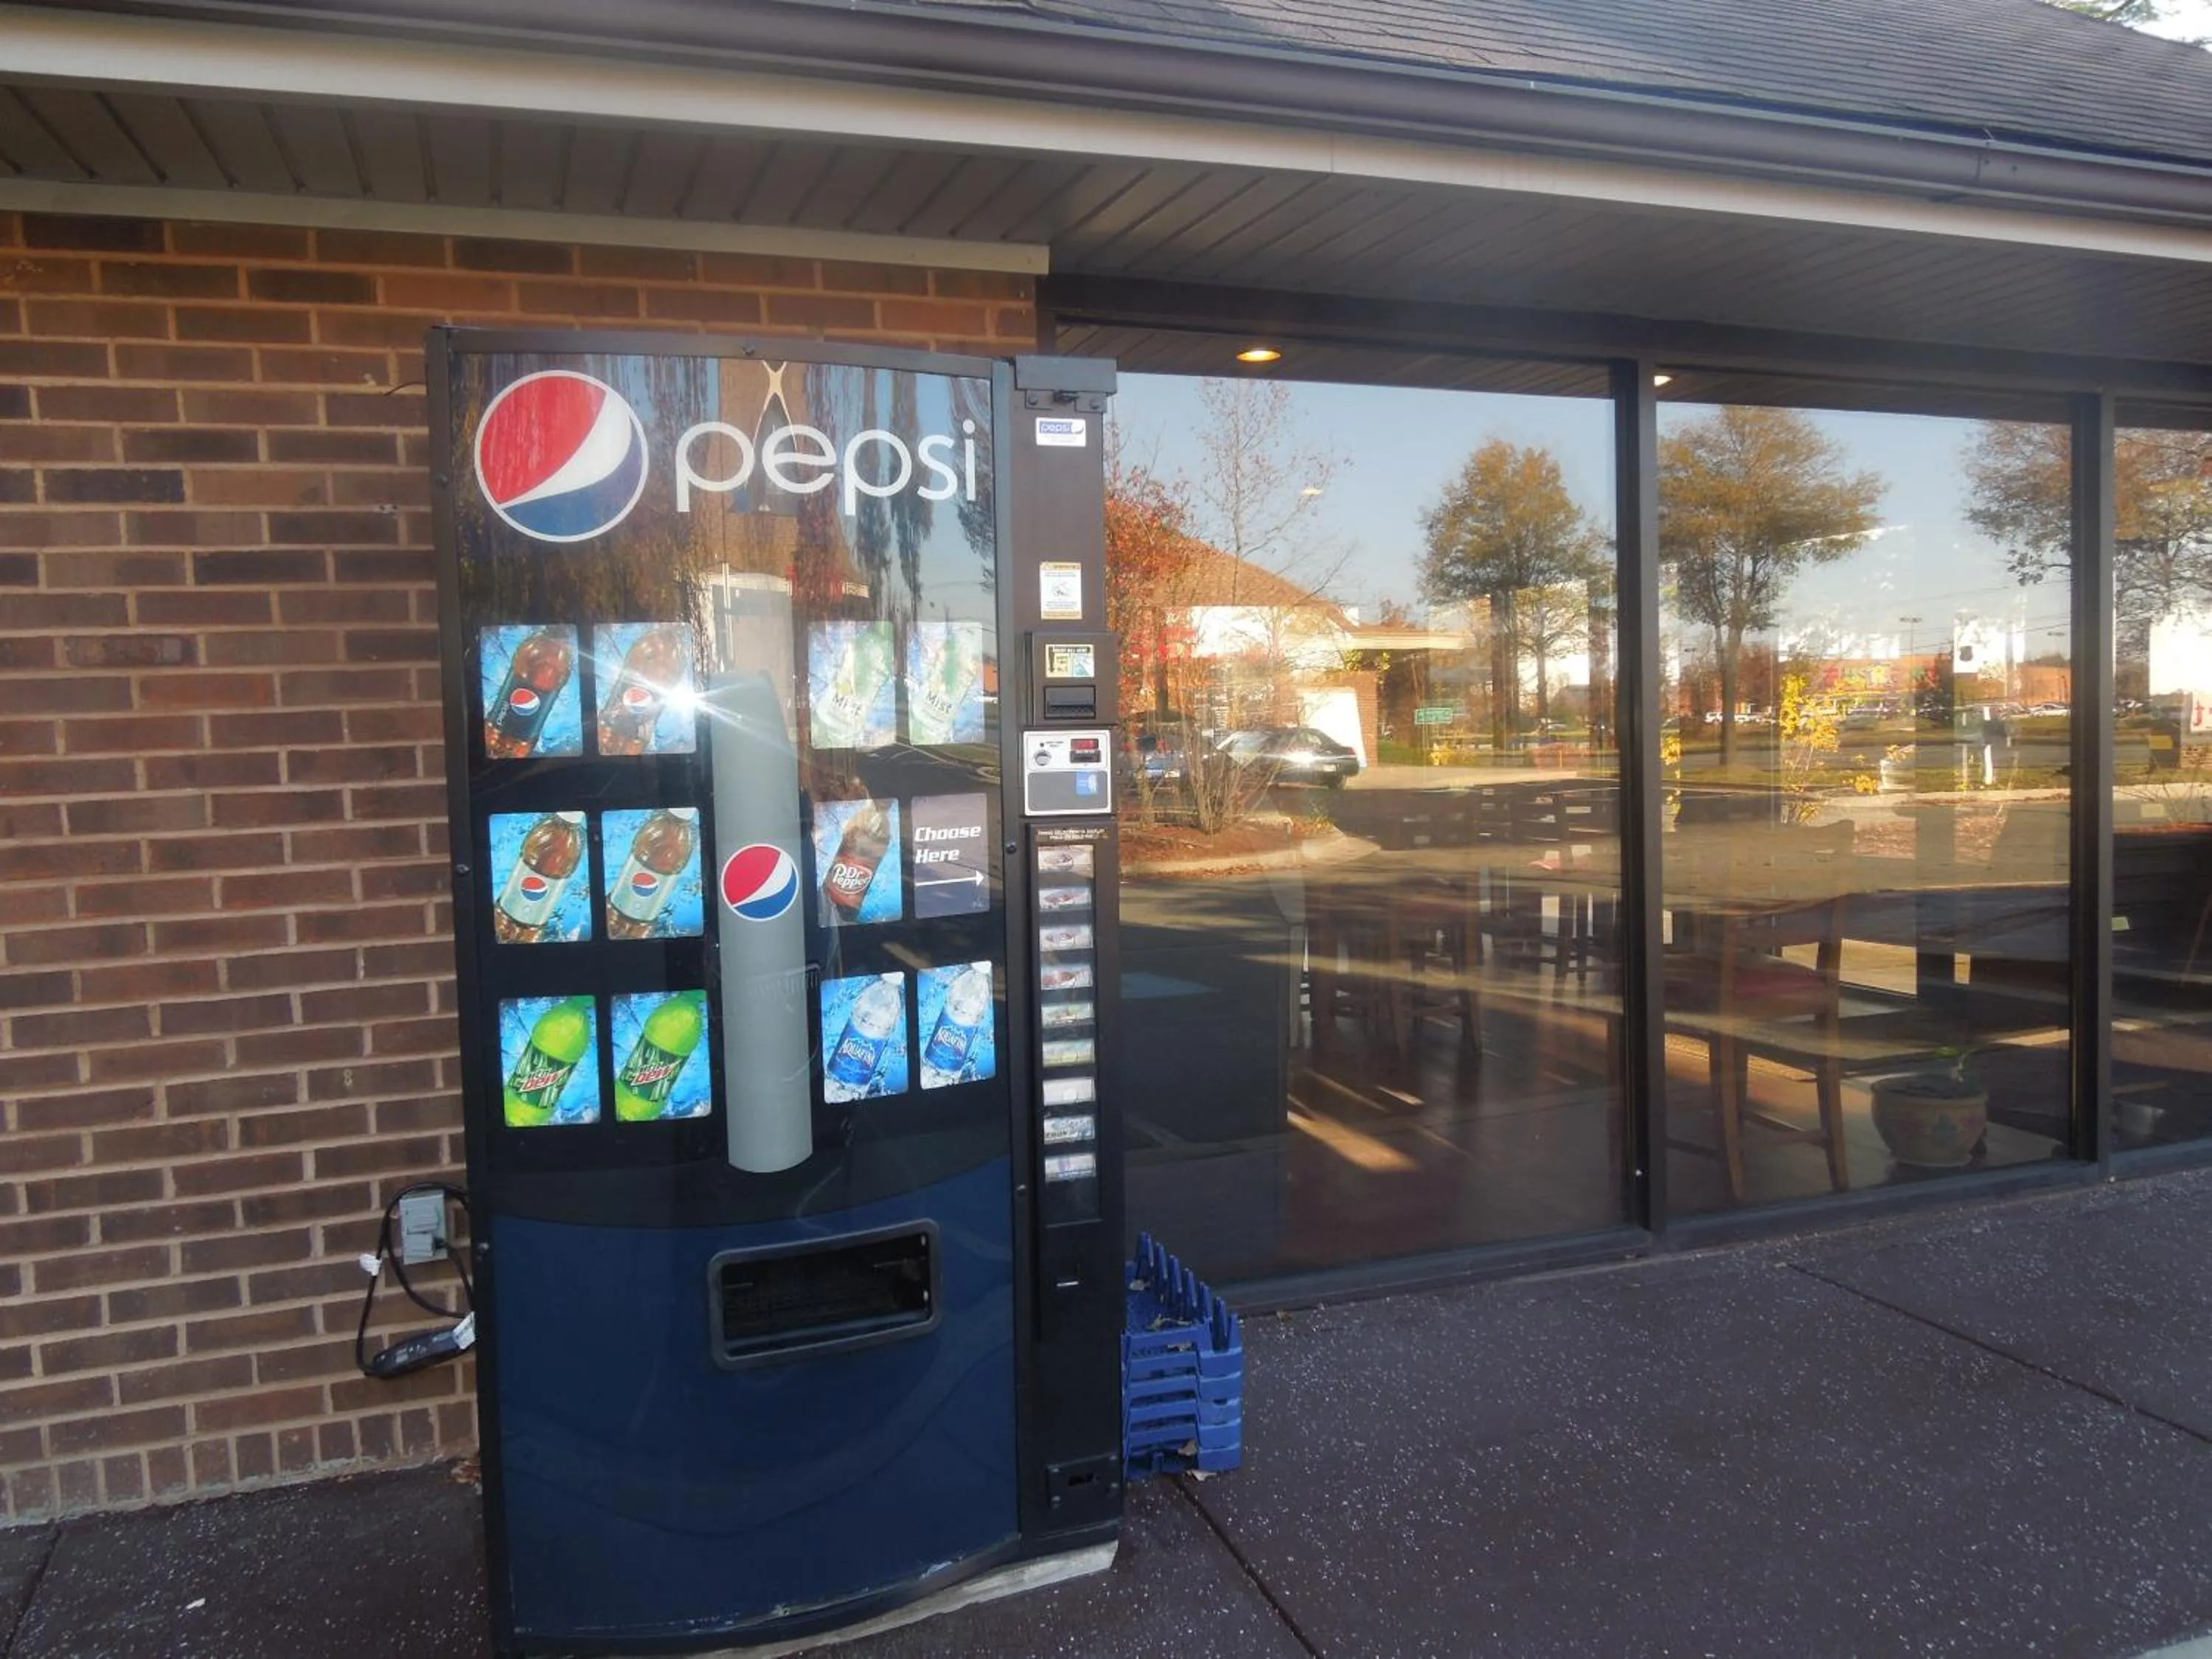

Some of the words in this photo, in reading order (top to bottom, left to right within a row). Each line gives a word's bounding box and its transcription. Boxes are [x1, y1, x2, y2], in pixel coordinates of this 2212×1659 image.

[675, 419, 976, 515] pepsi
[914, 826, 982, 842] Choose
[915, 849, 960, 864] Here
